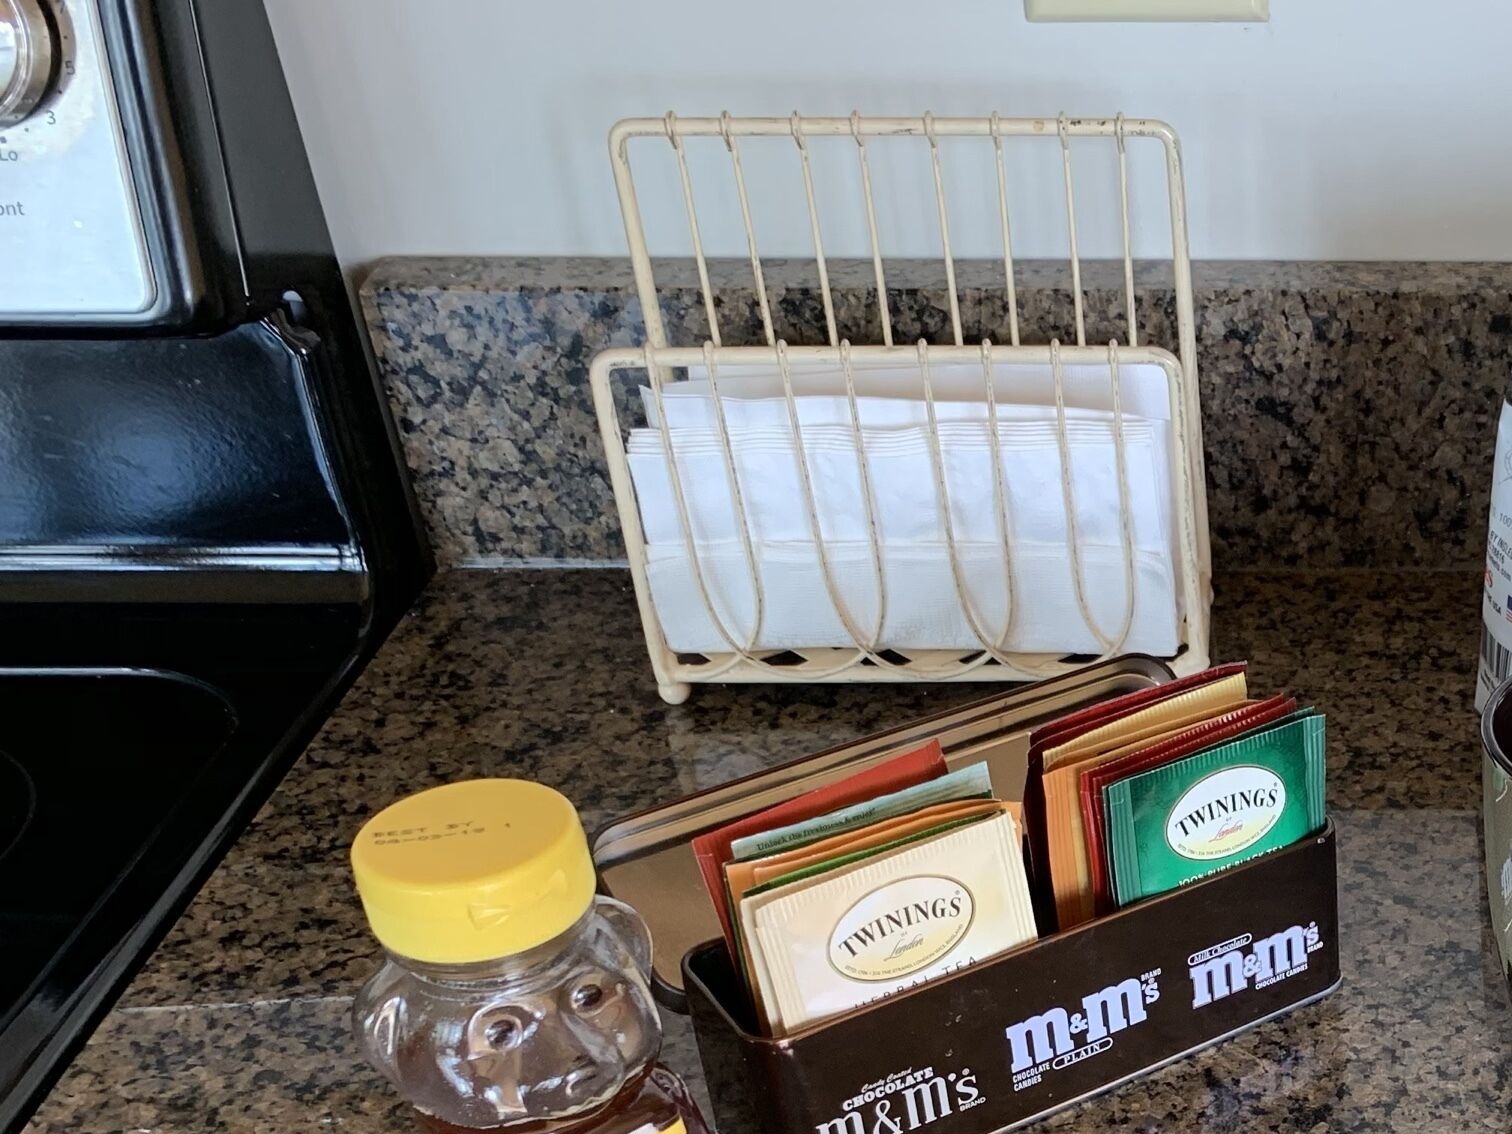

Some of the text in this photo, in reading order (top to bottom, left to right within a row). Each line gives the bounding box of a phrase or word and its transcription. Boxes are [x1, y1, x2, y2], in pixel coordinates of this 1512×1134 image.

[65, 60, 76, 76] 5
[46, 110, 57, 126] 3
[1174, 787, 1278, 838] TWININGS
[757, 836, 788, 852] Unlock
[838, 896, 962, 959] TWININGS
[882, 932, 925, 963] London
[1255, 972, 1287, 991] CHOCOLATE
[1063, 1041, 1102, 1066] PLAIN
[1011, 1061, 1051, 1084] CHOCOLATE
[1013, 1073, 1043, 1093] CANDIES
[842, 1065, 935, 1112] CHOCOLATE
[959, 1096, 987, 1112] BRAND
